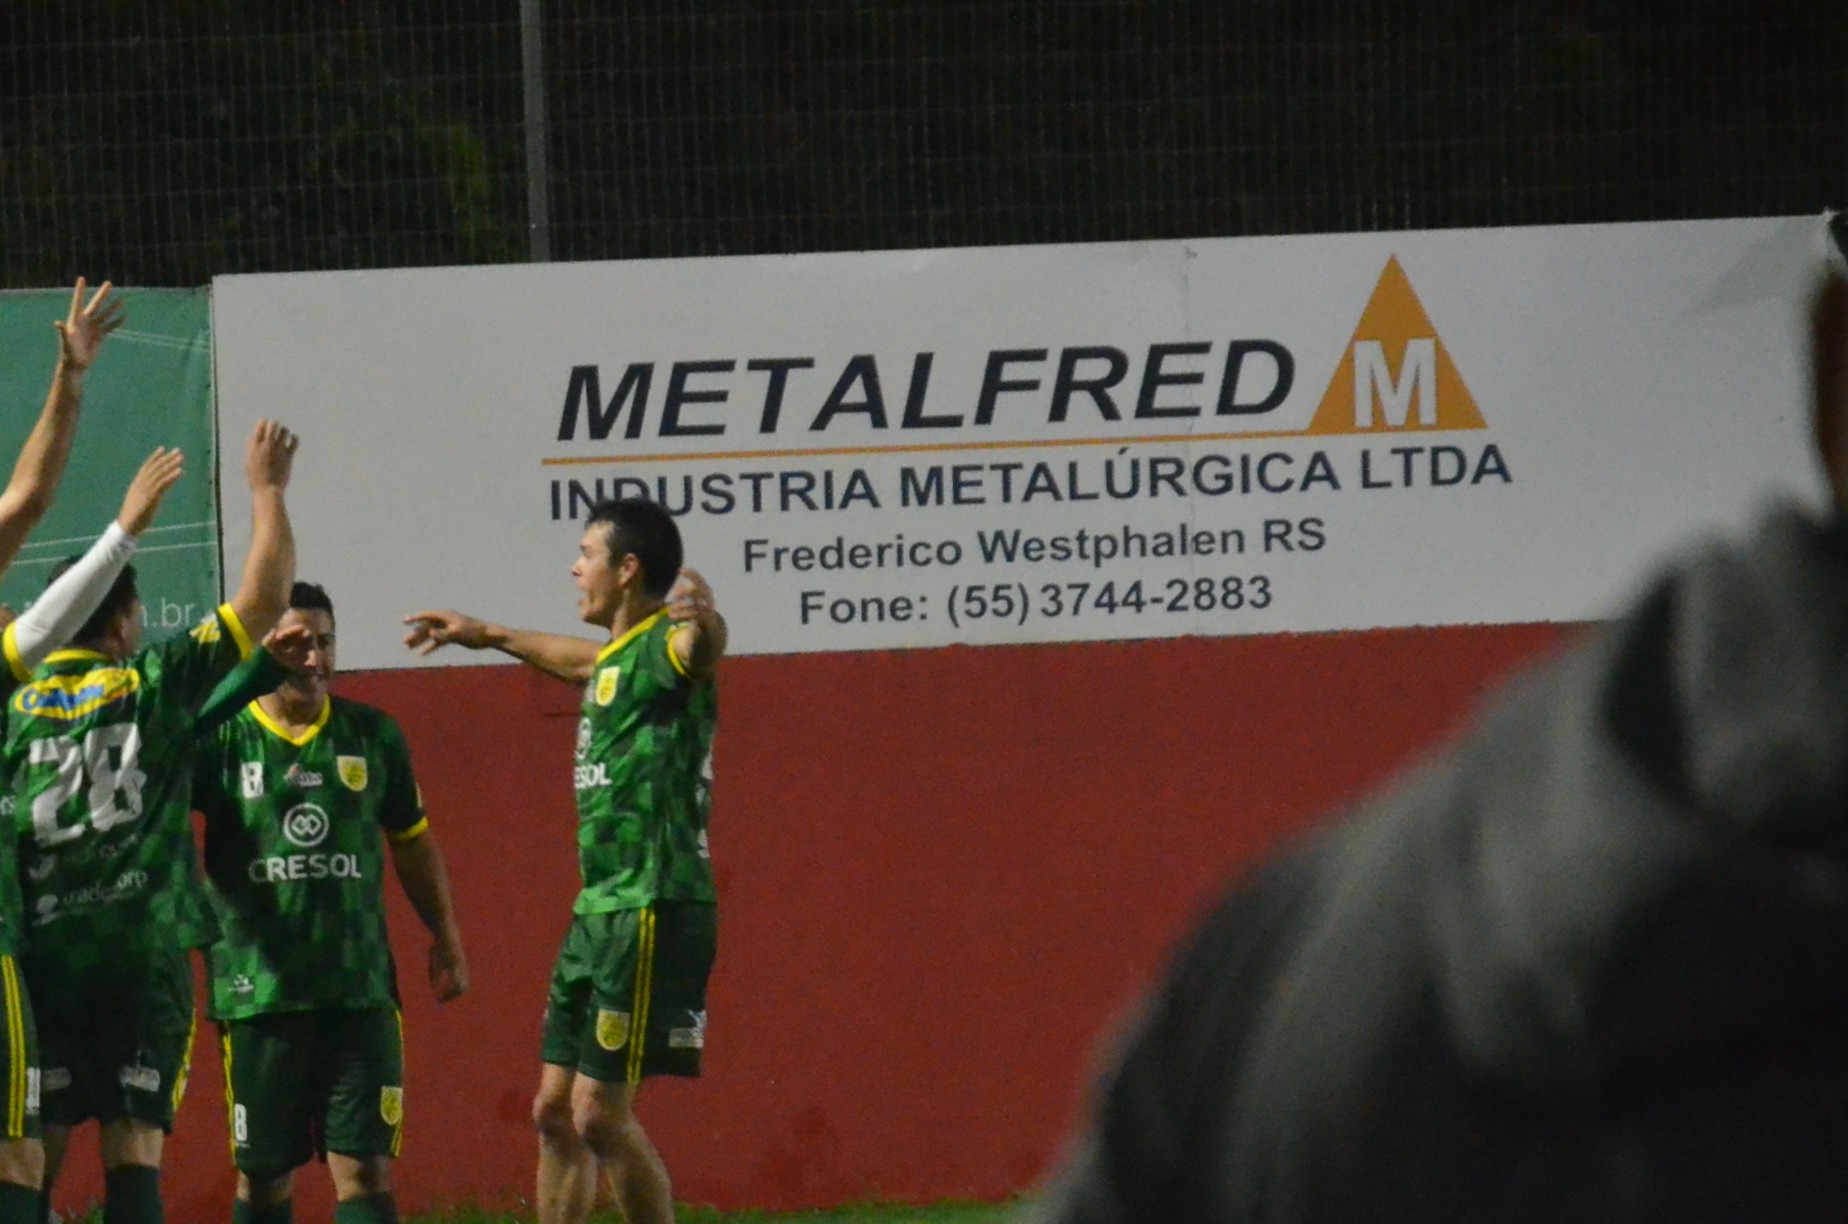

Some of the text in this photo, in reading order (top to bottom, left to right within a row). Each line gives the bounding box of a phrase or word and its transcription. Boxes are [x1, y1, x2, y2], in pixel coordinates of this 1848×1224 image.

[556, 337, 1296, 442] METALFRED
[1351, 336, 1438, 429] M
[549, 443, 1514, 521] INDUSTRIA METALÚRGICA LTDA
[743, 516, 1327, 573] Frederico Westphalen RS
[799, 575, 1273, 627] Fone: (55) 3744-2883
[29, 721, 147, 846] 28
[248, 853, 362, 883] CRESOL
[233, 1103, 248, 1142] 8
